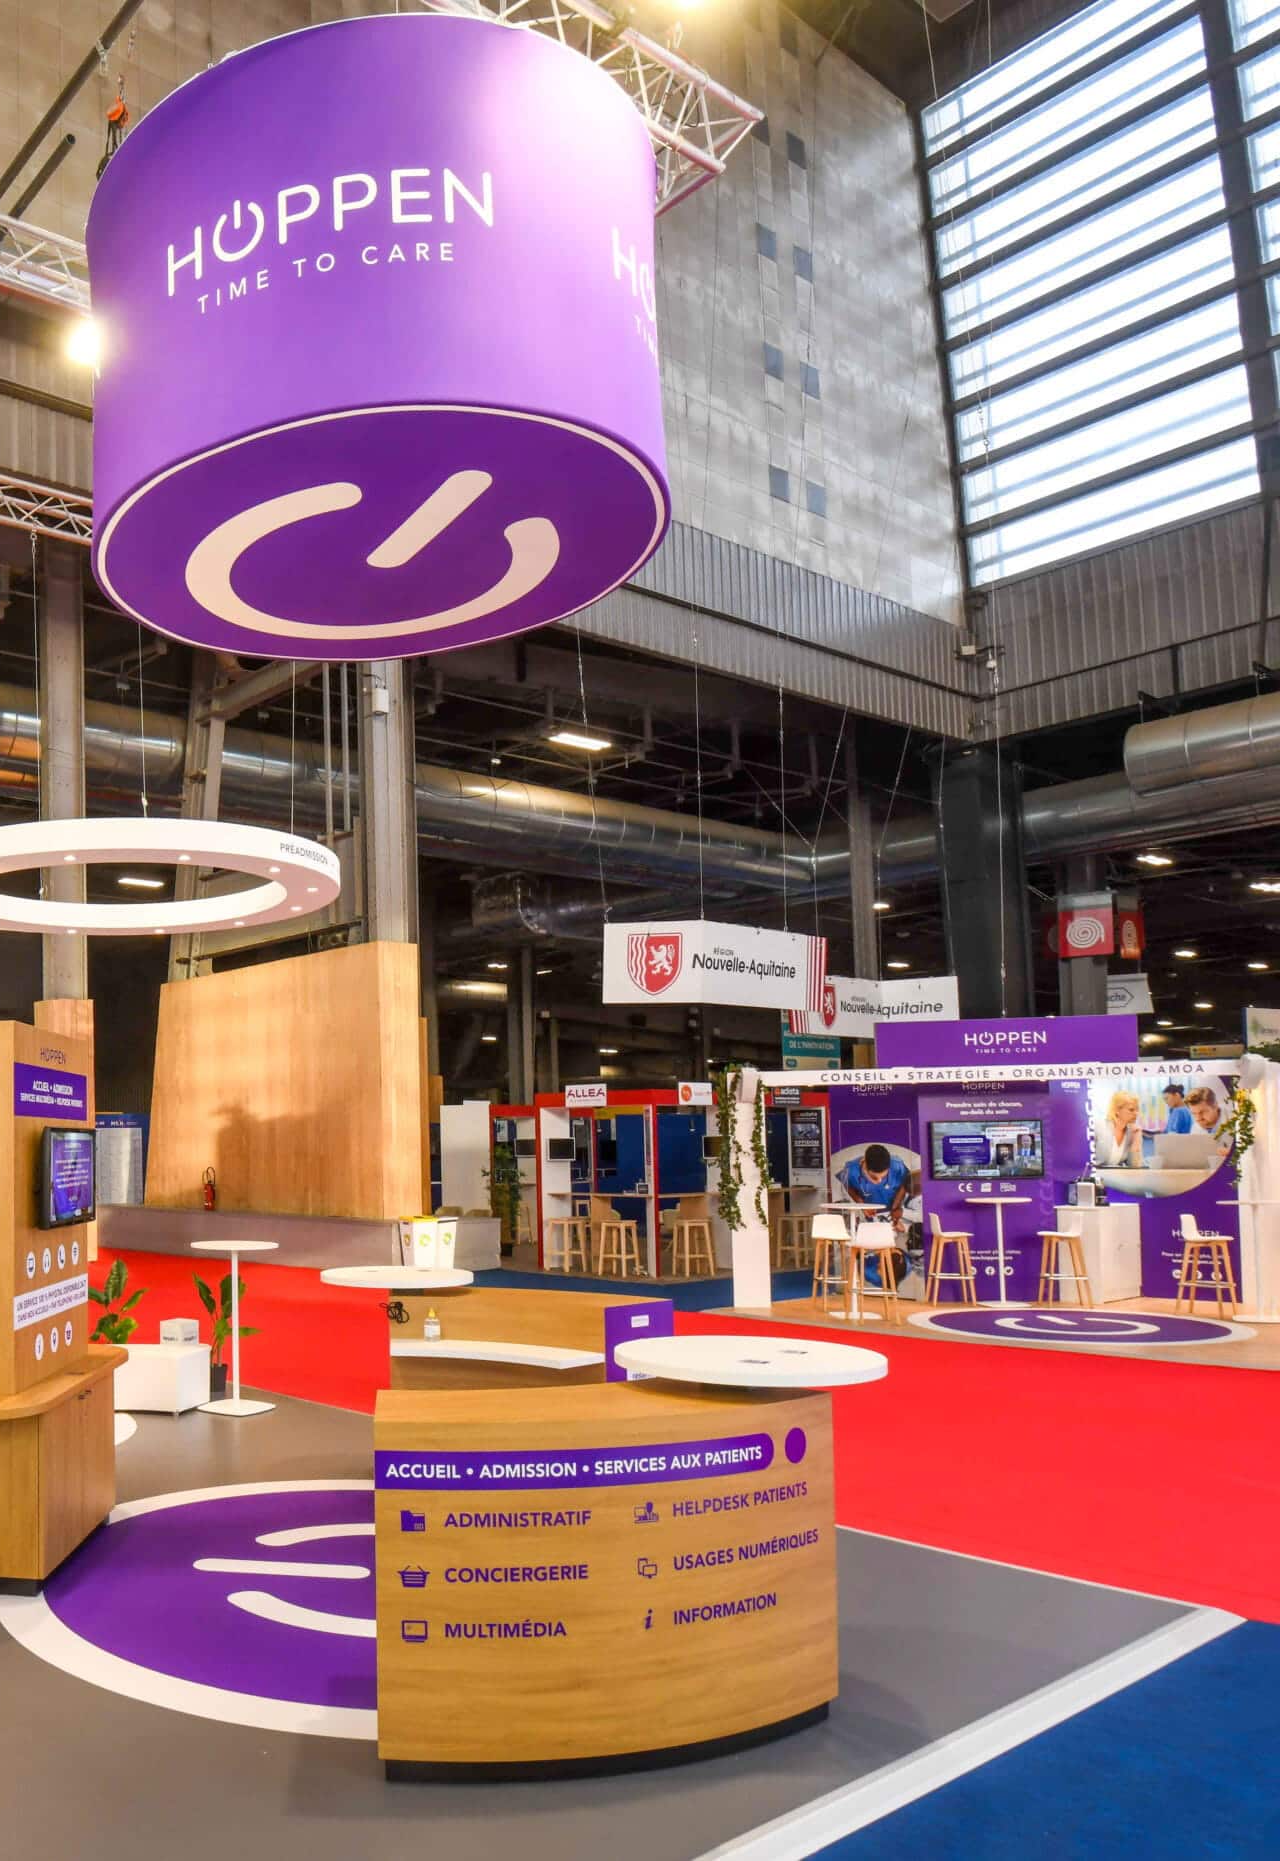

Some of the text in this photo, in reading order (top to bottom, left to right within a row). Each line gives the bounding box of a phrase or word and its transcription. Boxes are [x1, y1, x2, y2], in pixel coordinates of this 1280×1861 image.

[168, 168, 494, 297] HOPPEN
[197, 241, 455, 313] TIME TO CARE
[692, 953, 796, 980] Nouvelle-Aquitaine
[964, 1030, 1048, 1046] HOPPEN
[820, 1063, 1205, 1082] CONSEIL STRATÉGIE ORGANISATION AMOA
[567, 1087, 605, 1098] ALLEA
[386, 1445, 763, 1480] ACCUEIL ADMISSION SERVICES AUX PATIENTS
[672, 1481, 808, 1518] HELPDESK PATIENTS
[444, 1509, 592, 1529] ADMINISTRATIF
[673, 1528, 819, 1571] USAGES NUMÉRIQUES
[444, 1563, 589, 1584] CONCIERGERIE
[673, 1592, 777, 1625] INFORMATION
[444, 1618, 567, 1640] MULTIMÉDIA
